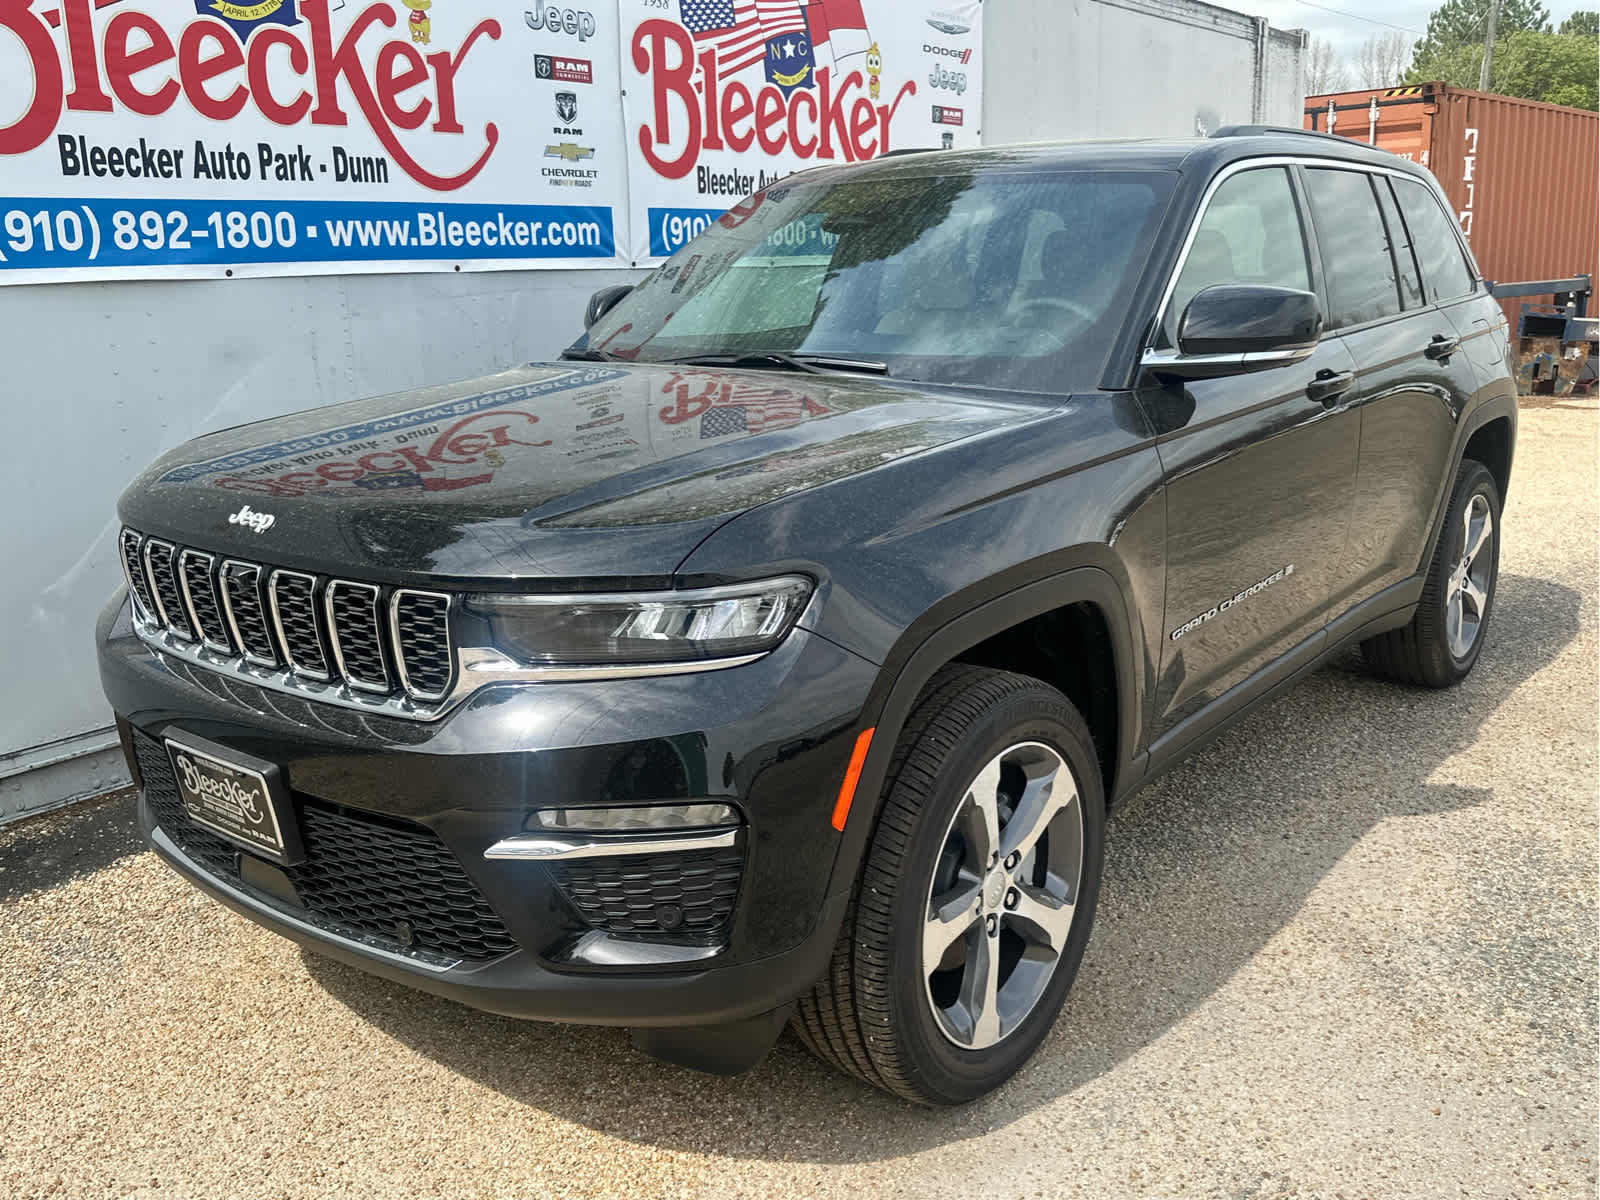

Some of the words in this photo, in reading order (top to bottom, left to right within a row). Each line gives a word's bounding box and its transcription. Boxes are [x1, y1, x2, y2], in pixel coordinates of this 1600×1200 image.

[525, 0, 596, 42] Jeep
[555, 60, 589, 73] RAM
[923, 45, 965, 58] DODGE
[928, 63, 967, 96] Jeep
[631, 18, 916, 179] Bleecker
[943, 109, 961, 118] RAM
[553, 127, 583, 136] RAM
[58, 134, 185, 180] Bleecker
[193, 140, 252, 181] Auto
[259, 144, 315, 182] Park
[332, 146, 390, 184] Dunn
[541, 167, 598, 179] CHEVROLET
[696, 165, 756, 196] Bleecker
[0, 205, 101, 262] 910)
[112, 209, 297, 250] 892-1800
[325, 212, 601, 247] www.Bleecker.com
[229, 504, 276, 534] Jeep
[1170, 607, 1218, 640] GRAND
[1218, 568, 1285, 612] CHEROKEE
[176, 754, 264, 824] Bleecker
